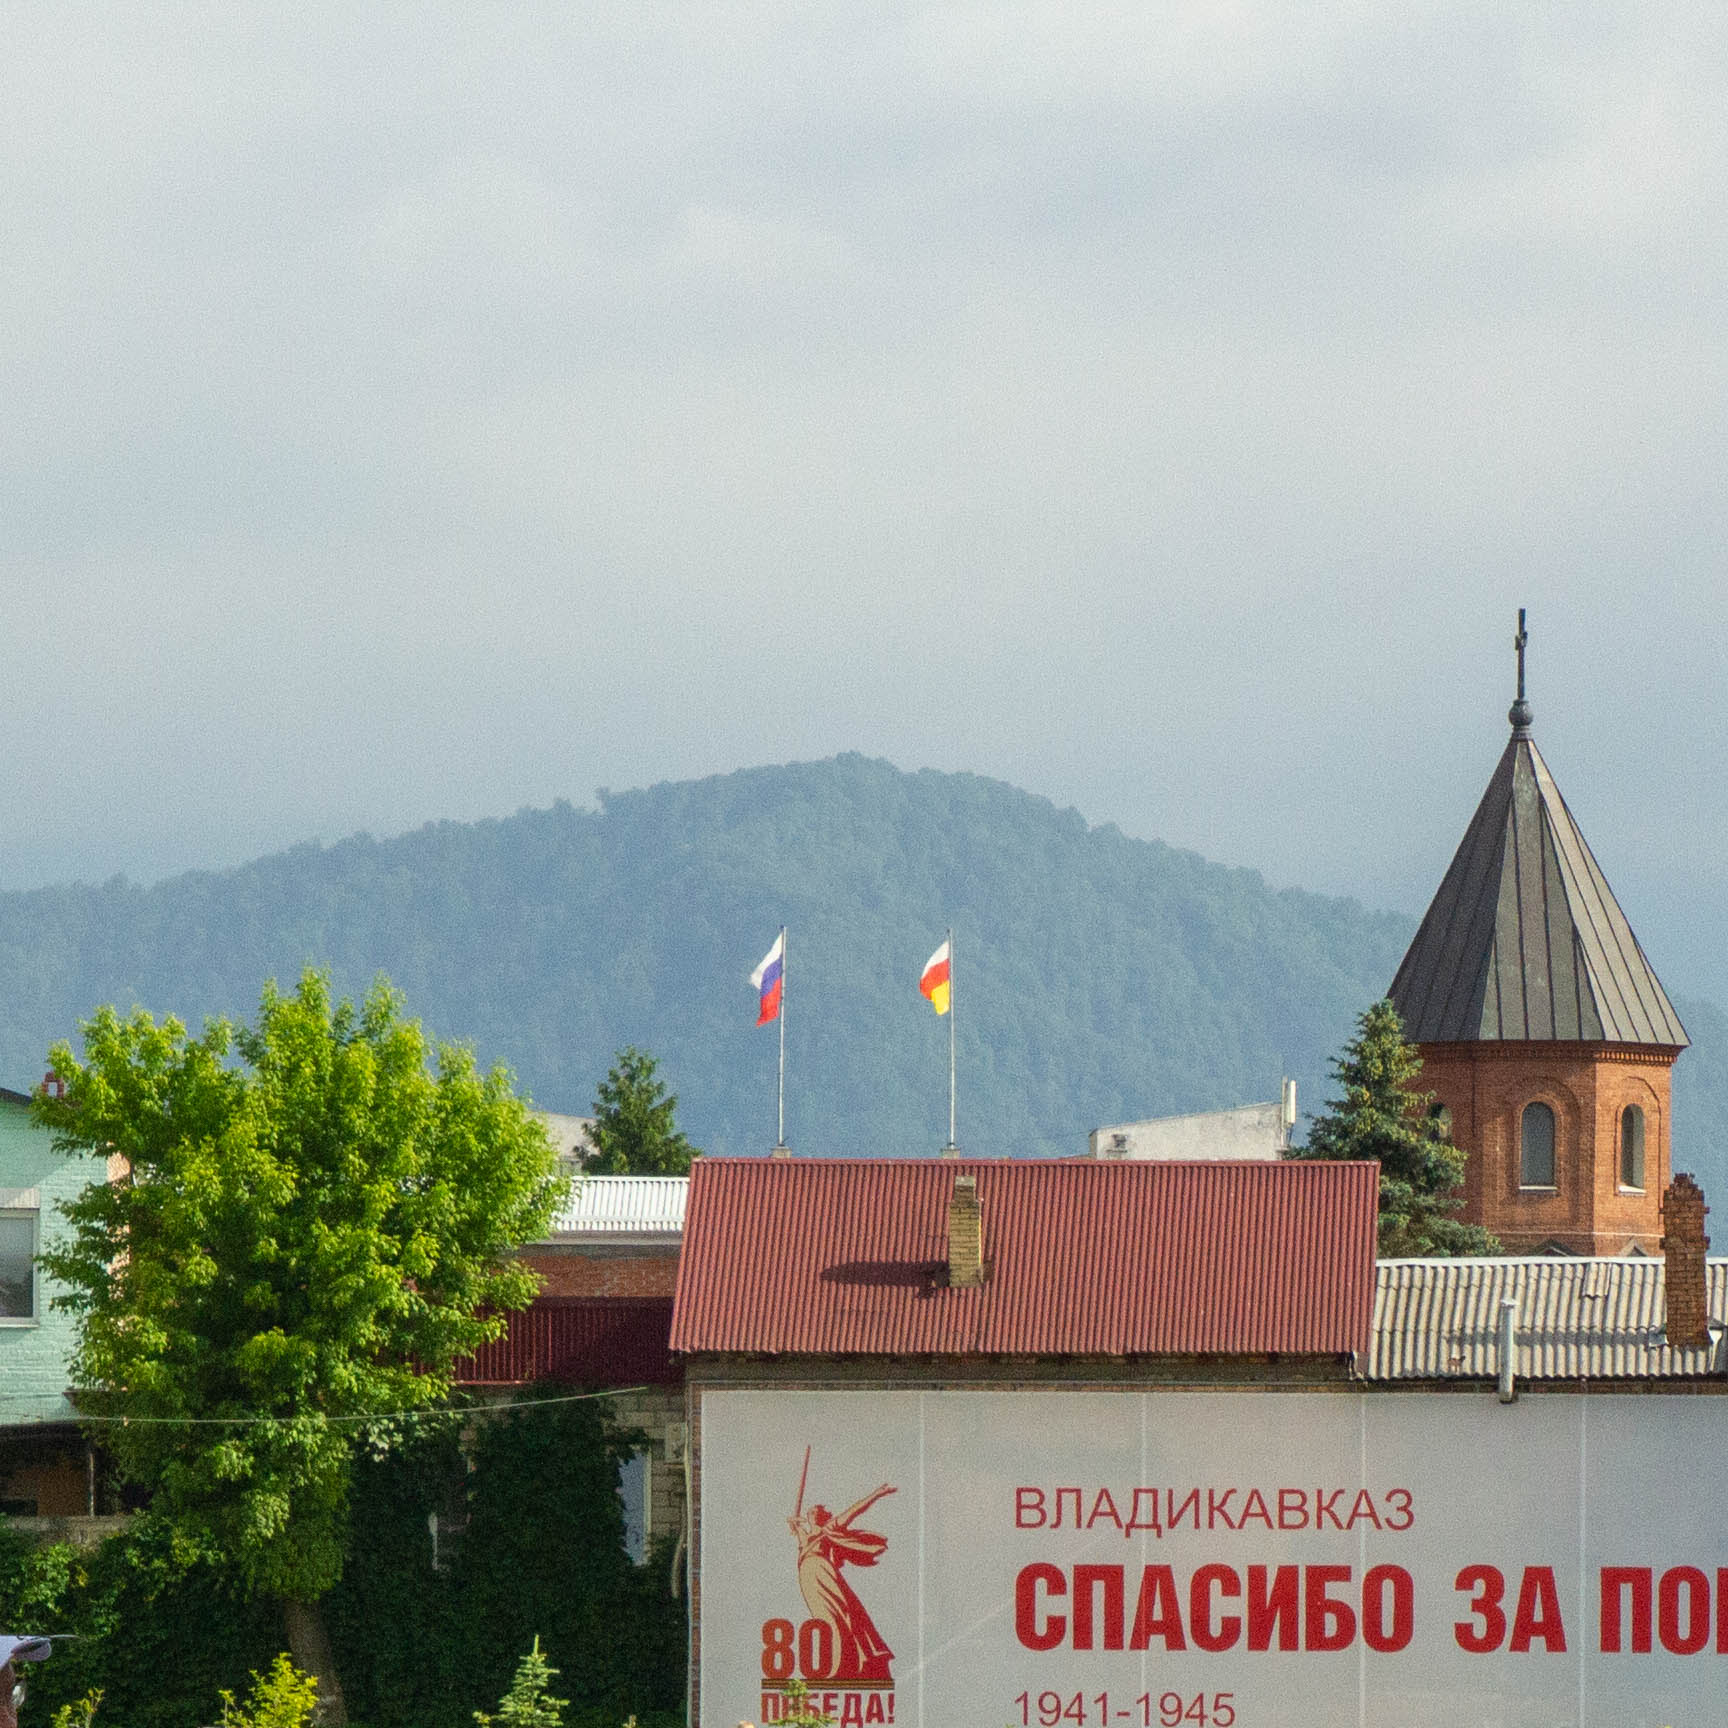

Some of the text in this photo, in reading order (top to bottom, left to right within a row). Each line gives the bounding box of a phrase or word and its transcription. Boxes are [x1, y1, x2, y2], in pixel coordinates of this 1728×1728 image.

[1015, 1486, 1415, 1539] ВЛАДИКАВКАЗ
[1015, 1562, 1415, 1653] СПАСИБО
[1454, 1564, 1567, 1654] ЗА
[761, 1618, 833, 1679] 80
[1014, 1691, 1236, 1728] 1941-1945
